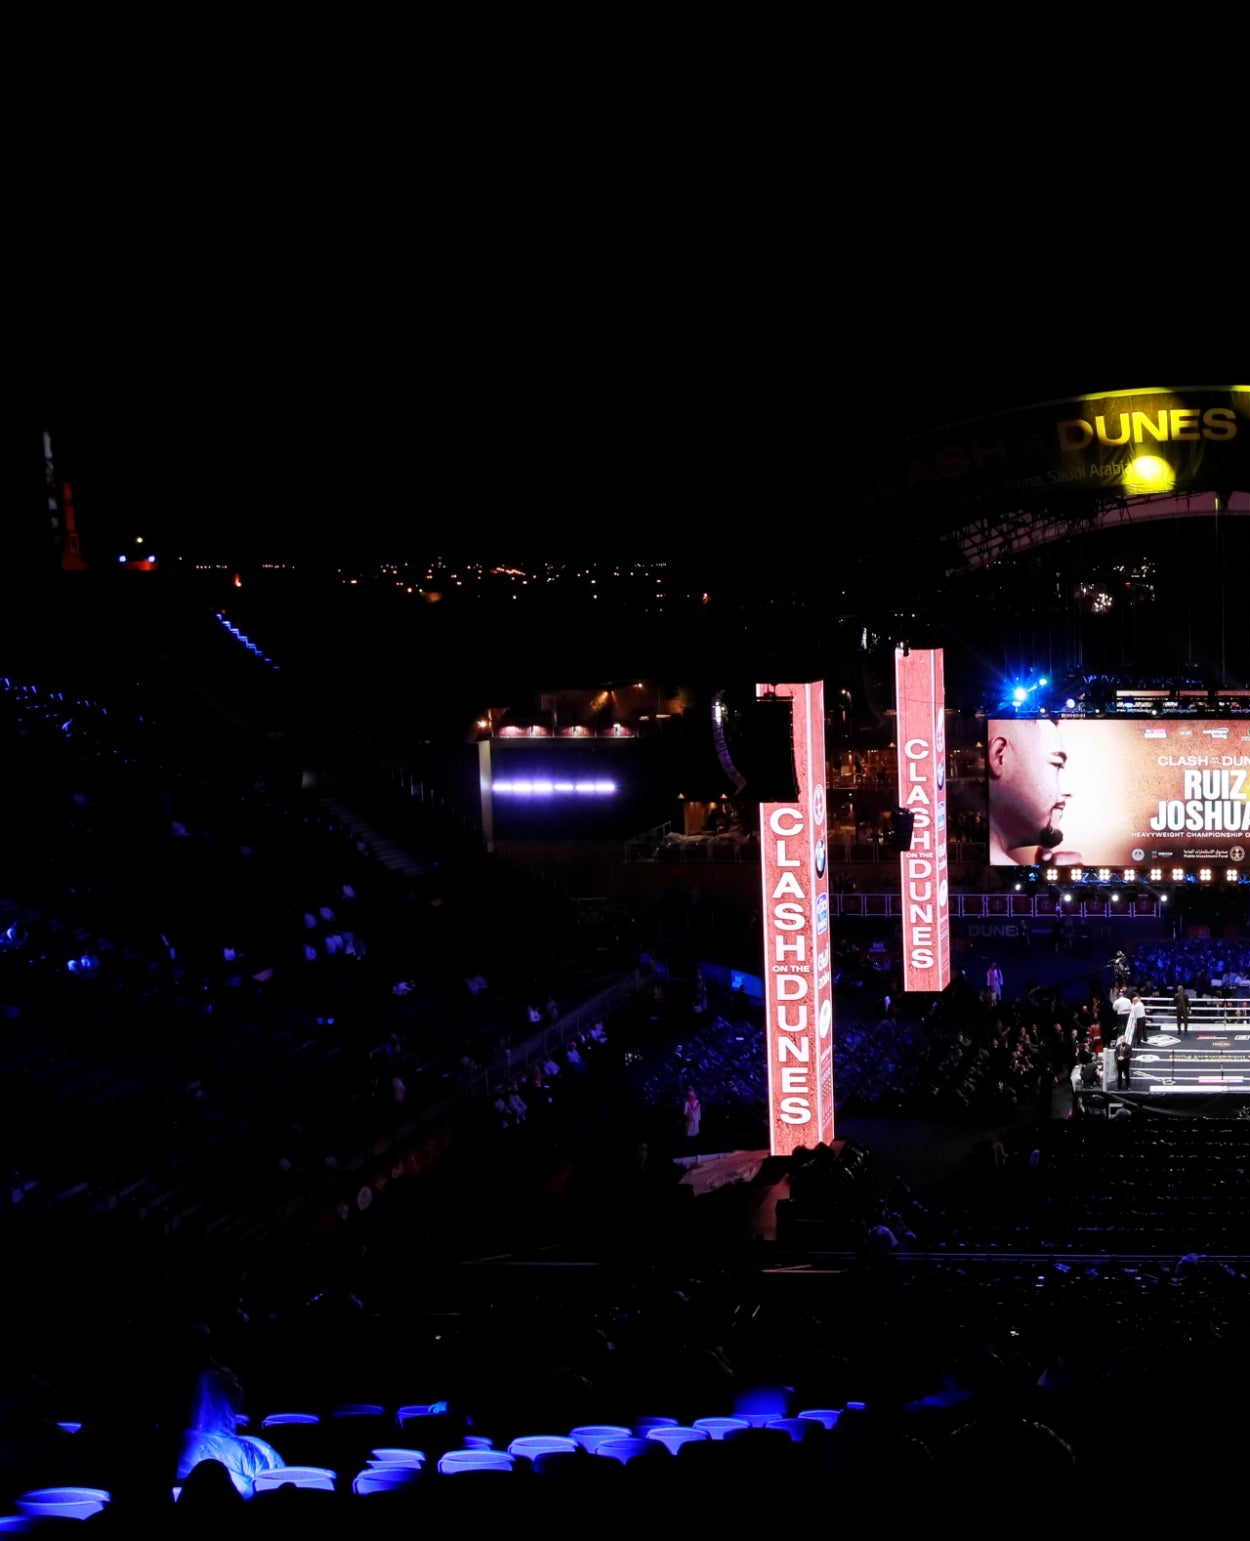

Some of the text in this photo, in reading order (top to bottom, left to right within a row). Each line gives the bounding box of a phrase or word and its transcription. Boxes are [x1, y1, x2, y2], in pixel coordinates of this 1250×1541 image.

[1055, 407, 1239, 454] DUNES
[1157, 755, 1208, 767] CLASH
[1184, 769, 1247, 800] RUIZ
[1131, 831, 1184, 839] HEAVYWEIGHT
[1186, 831, 1243, 839] CHAMPIONSHIP
[769, 807, 806, 962] CLASH
[908, 859, 935, 969] DUNES
[968, 924, 1020, 937] DUNE
[772, 965, 810, 973] ON THE
[776, 974, 812, 1125] DUNES
